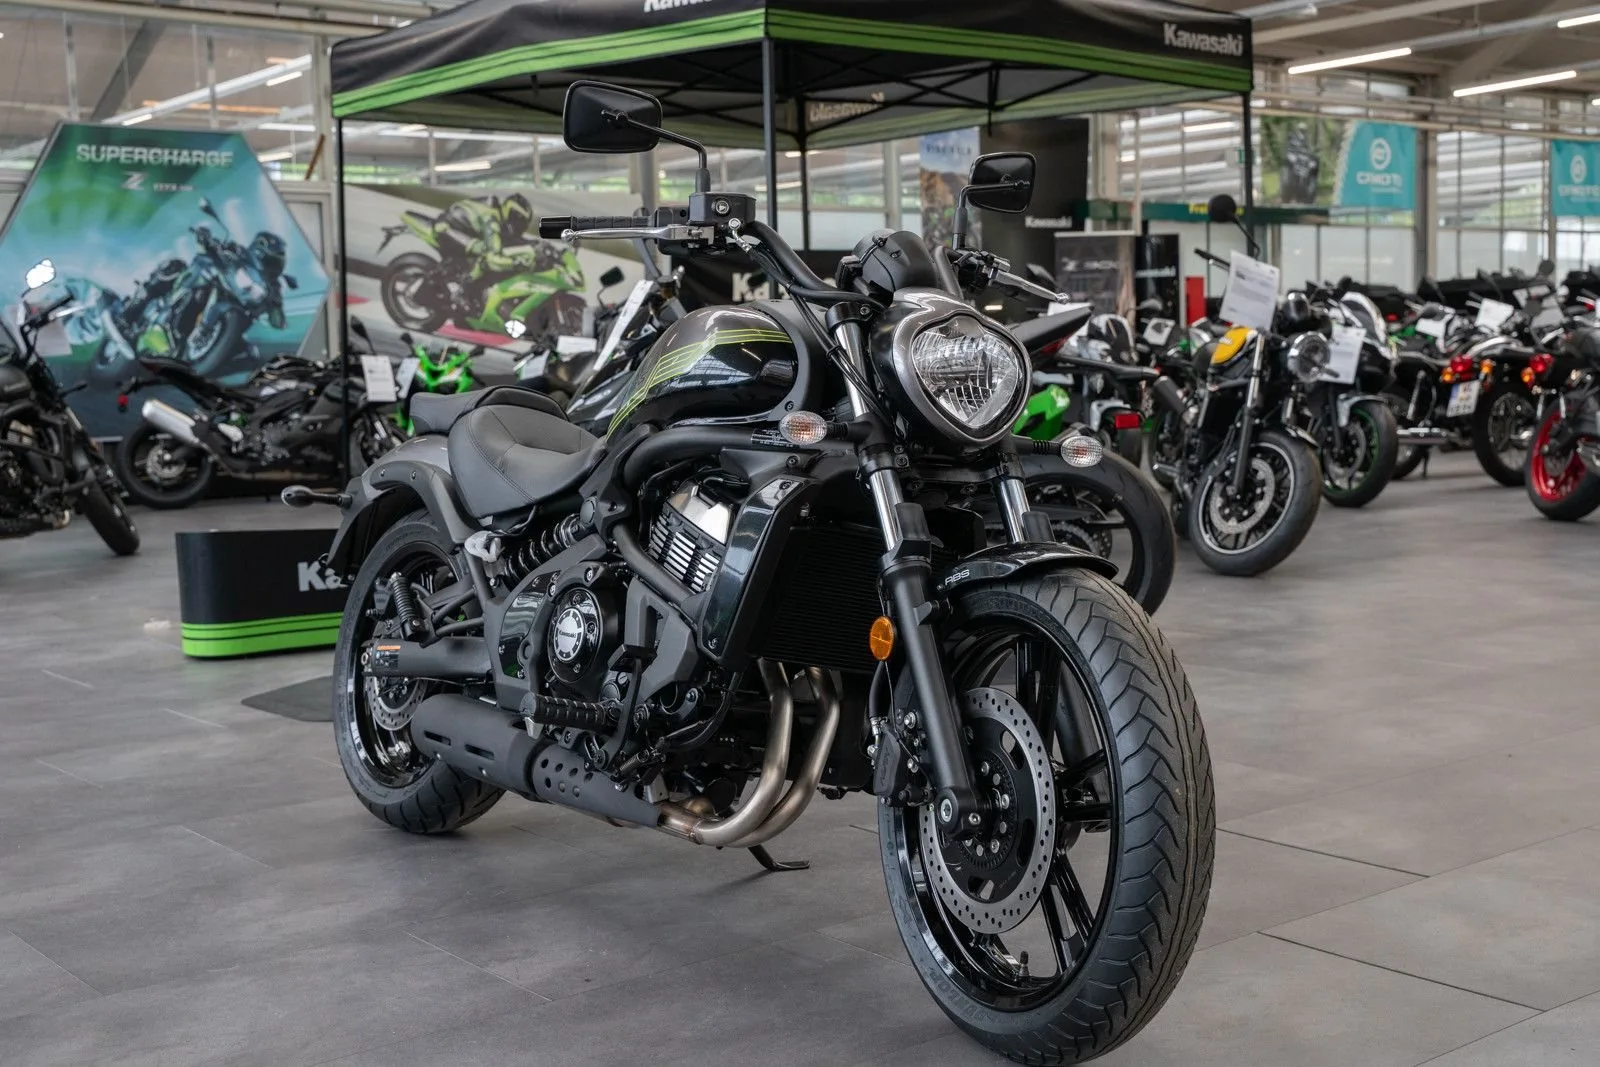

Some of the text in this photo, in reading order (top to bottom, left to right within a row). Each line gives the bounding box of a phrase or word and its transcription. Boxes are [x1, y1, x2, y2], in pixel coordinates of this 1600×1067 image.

[1163, 22, 1244, 57] Kawasaki
[76, 143, 234, 167] SUPERCHARGE
[945, 569, 970, 586] ABS
